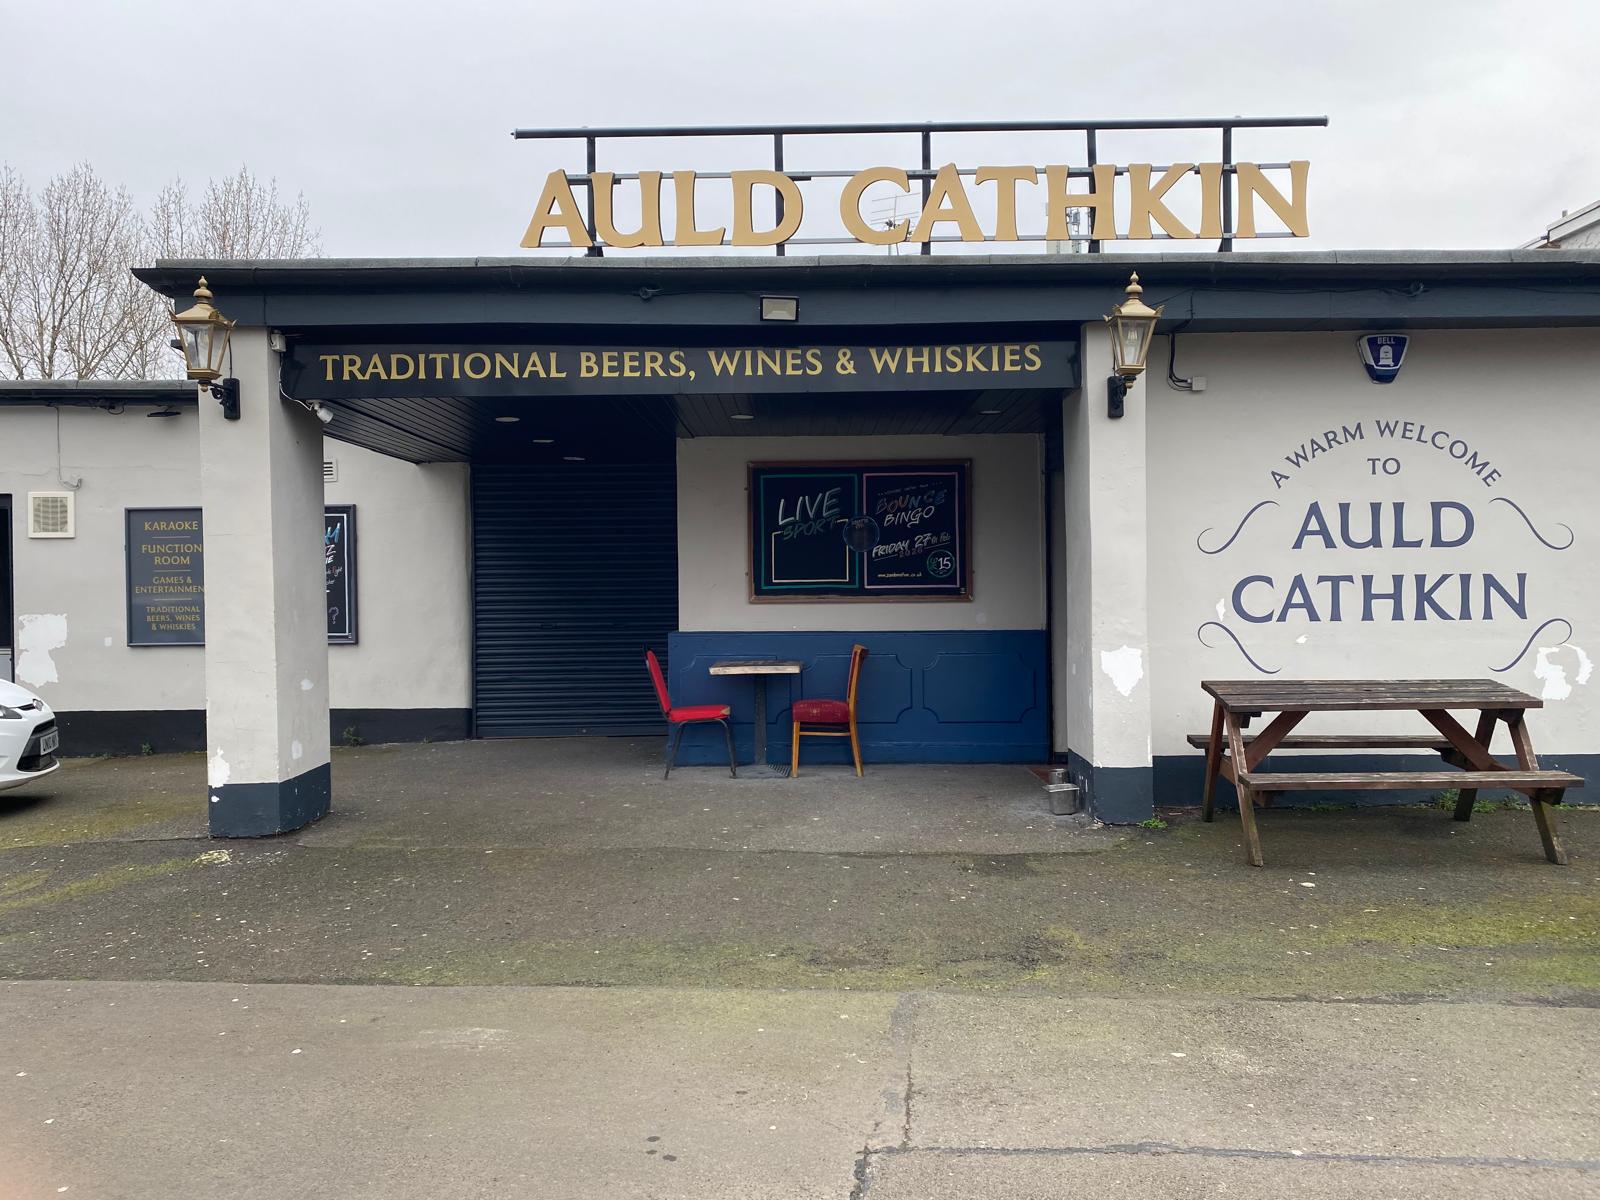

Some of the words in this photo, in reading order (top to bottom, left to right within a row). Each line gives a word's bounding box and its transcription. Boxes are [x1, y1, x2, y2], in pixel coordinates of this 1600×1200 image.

[520, 168, 804, 248] AULD
[839, 160, 1310, 246] CATHKIN
[319, 351, 566, 383] TRADITIONAL
[579, 350, 696, 382] BEERS,
[708, 348, 823, 377] WINES
[835, 348, 857, 376] &
[869, 343, 1043, 374] WHISKIES
[1270, 469, 1290, 489] A
[1284, 421, 1366, 469] WARM
[1375, 419, 1502, 488] WELCOME
[1367, 457, 1401, 475] TO
[777, 487, 842, 526] LIVE
[874, 488, 948, 515] BOUNCE
[143, 521, 199, 531] KARAOKE
[883, 505, 935, 528] BINGO
[1291, 500, 1475, 550] AULD
[782, 516, 837, 541] SPORT
[141, 543, 202, 553] FUNCTION
[871, 539, 911, 559] FRIDAY
[153, 556, 190, 565] ROOM
[135, 585, 205, 594] ENTERTAINMEN
[152, 576, 185, 585] GAMES
[186, 576, 193, 584] &
[1231, 572, 1528, 624] CATHKIN
[145, 606, 200, 614] TRADITIONAL
[175, 614, 201, 622] WINES
[159, 622, 196, 631] WHISKIES
